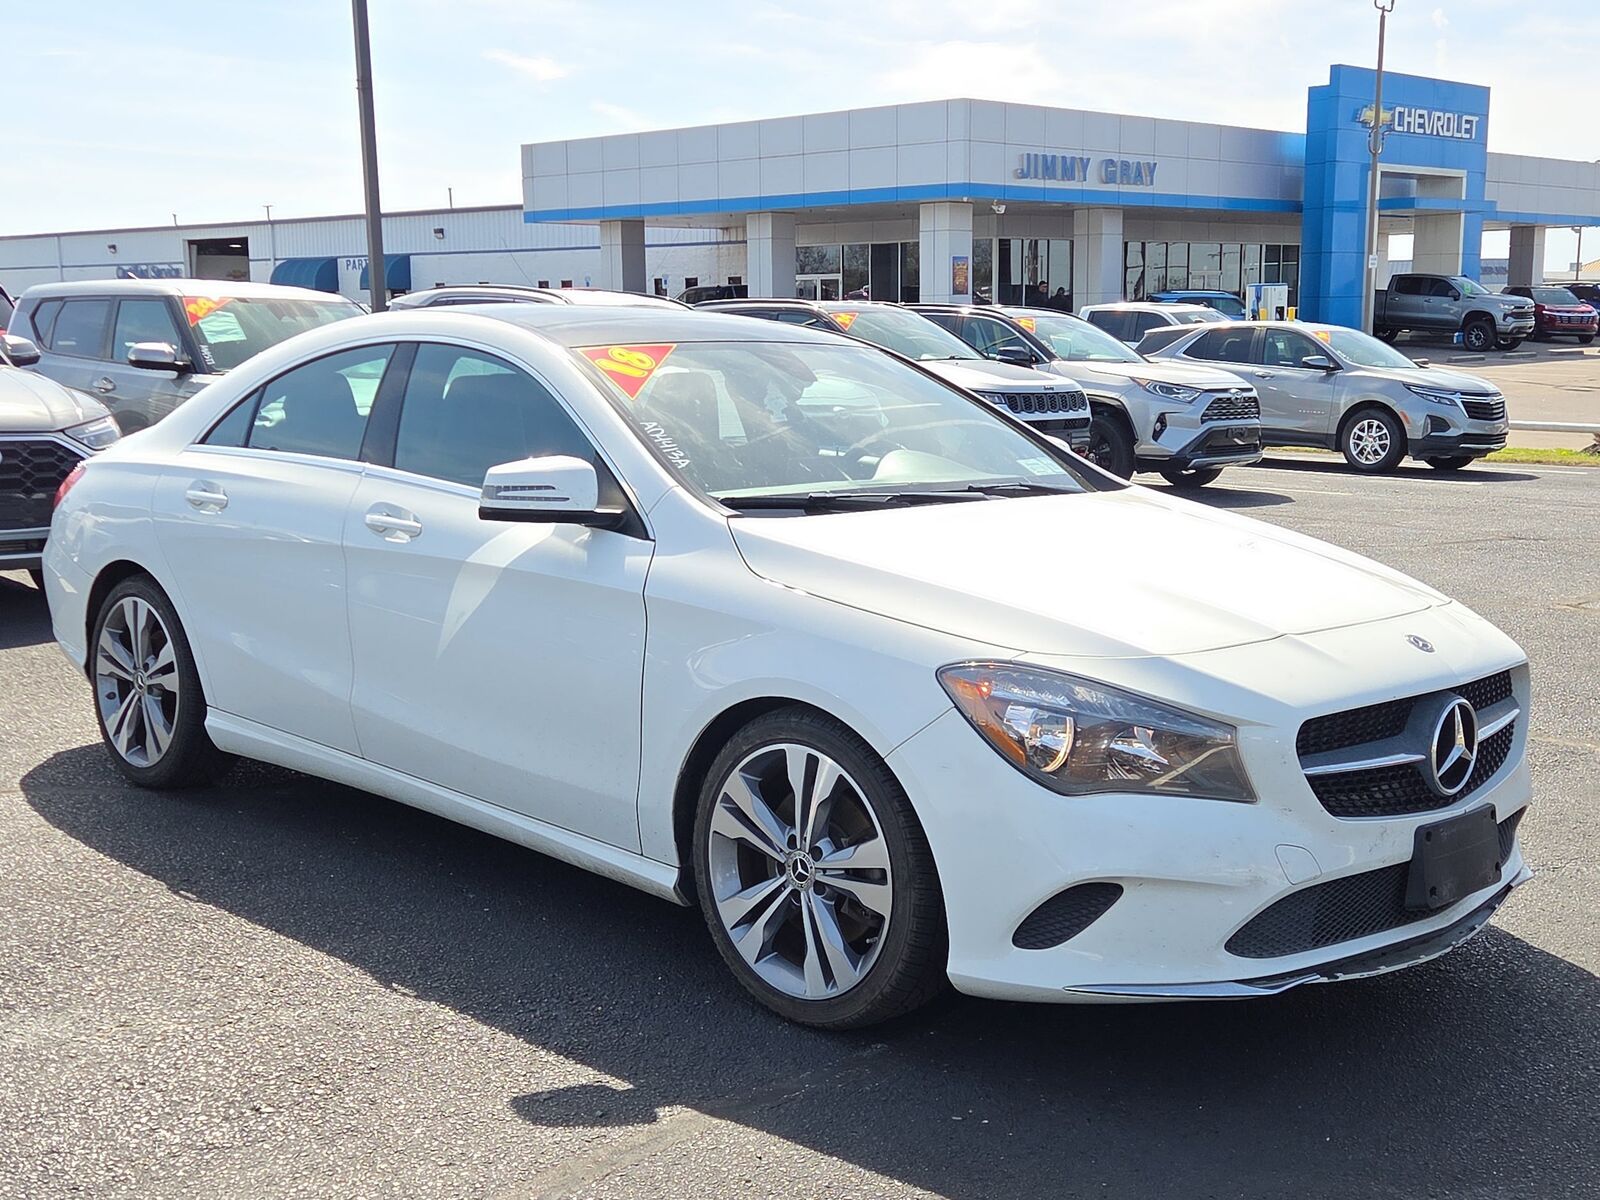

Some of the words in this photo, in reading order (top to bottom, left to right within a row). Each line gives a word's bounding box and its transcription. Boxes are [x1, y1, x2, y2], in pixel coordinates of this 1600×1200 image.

[1394, 106, 1479, 139] CHEVROLET
[1014, 152, 1091, 182] JIMMY
[1099, 158, 1157, 187] GRAY
[594, 347, 656, 378] 18
